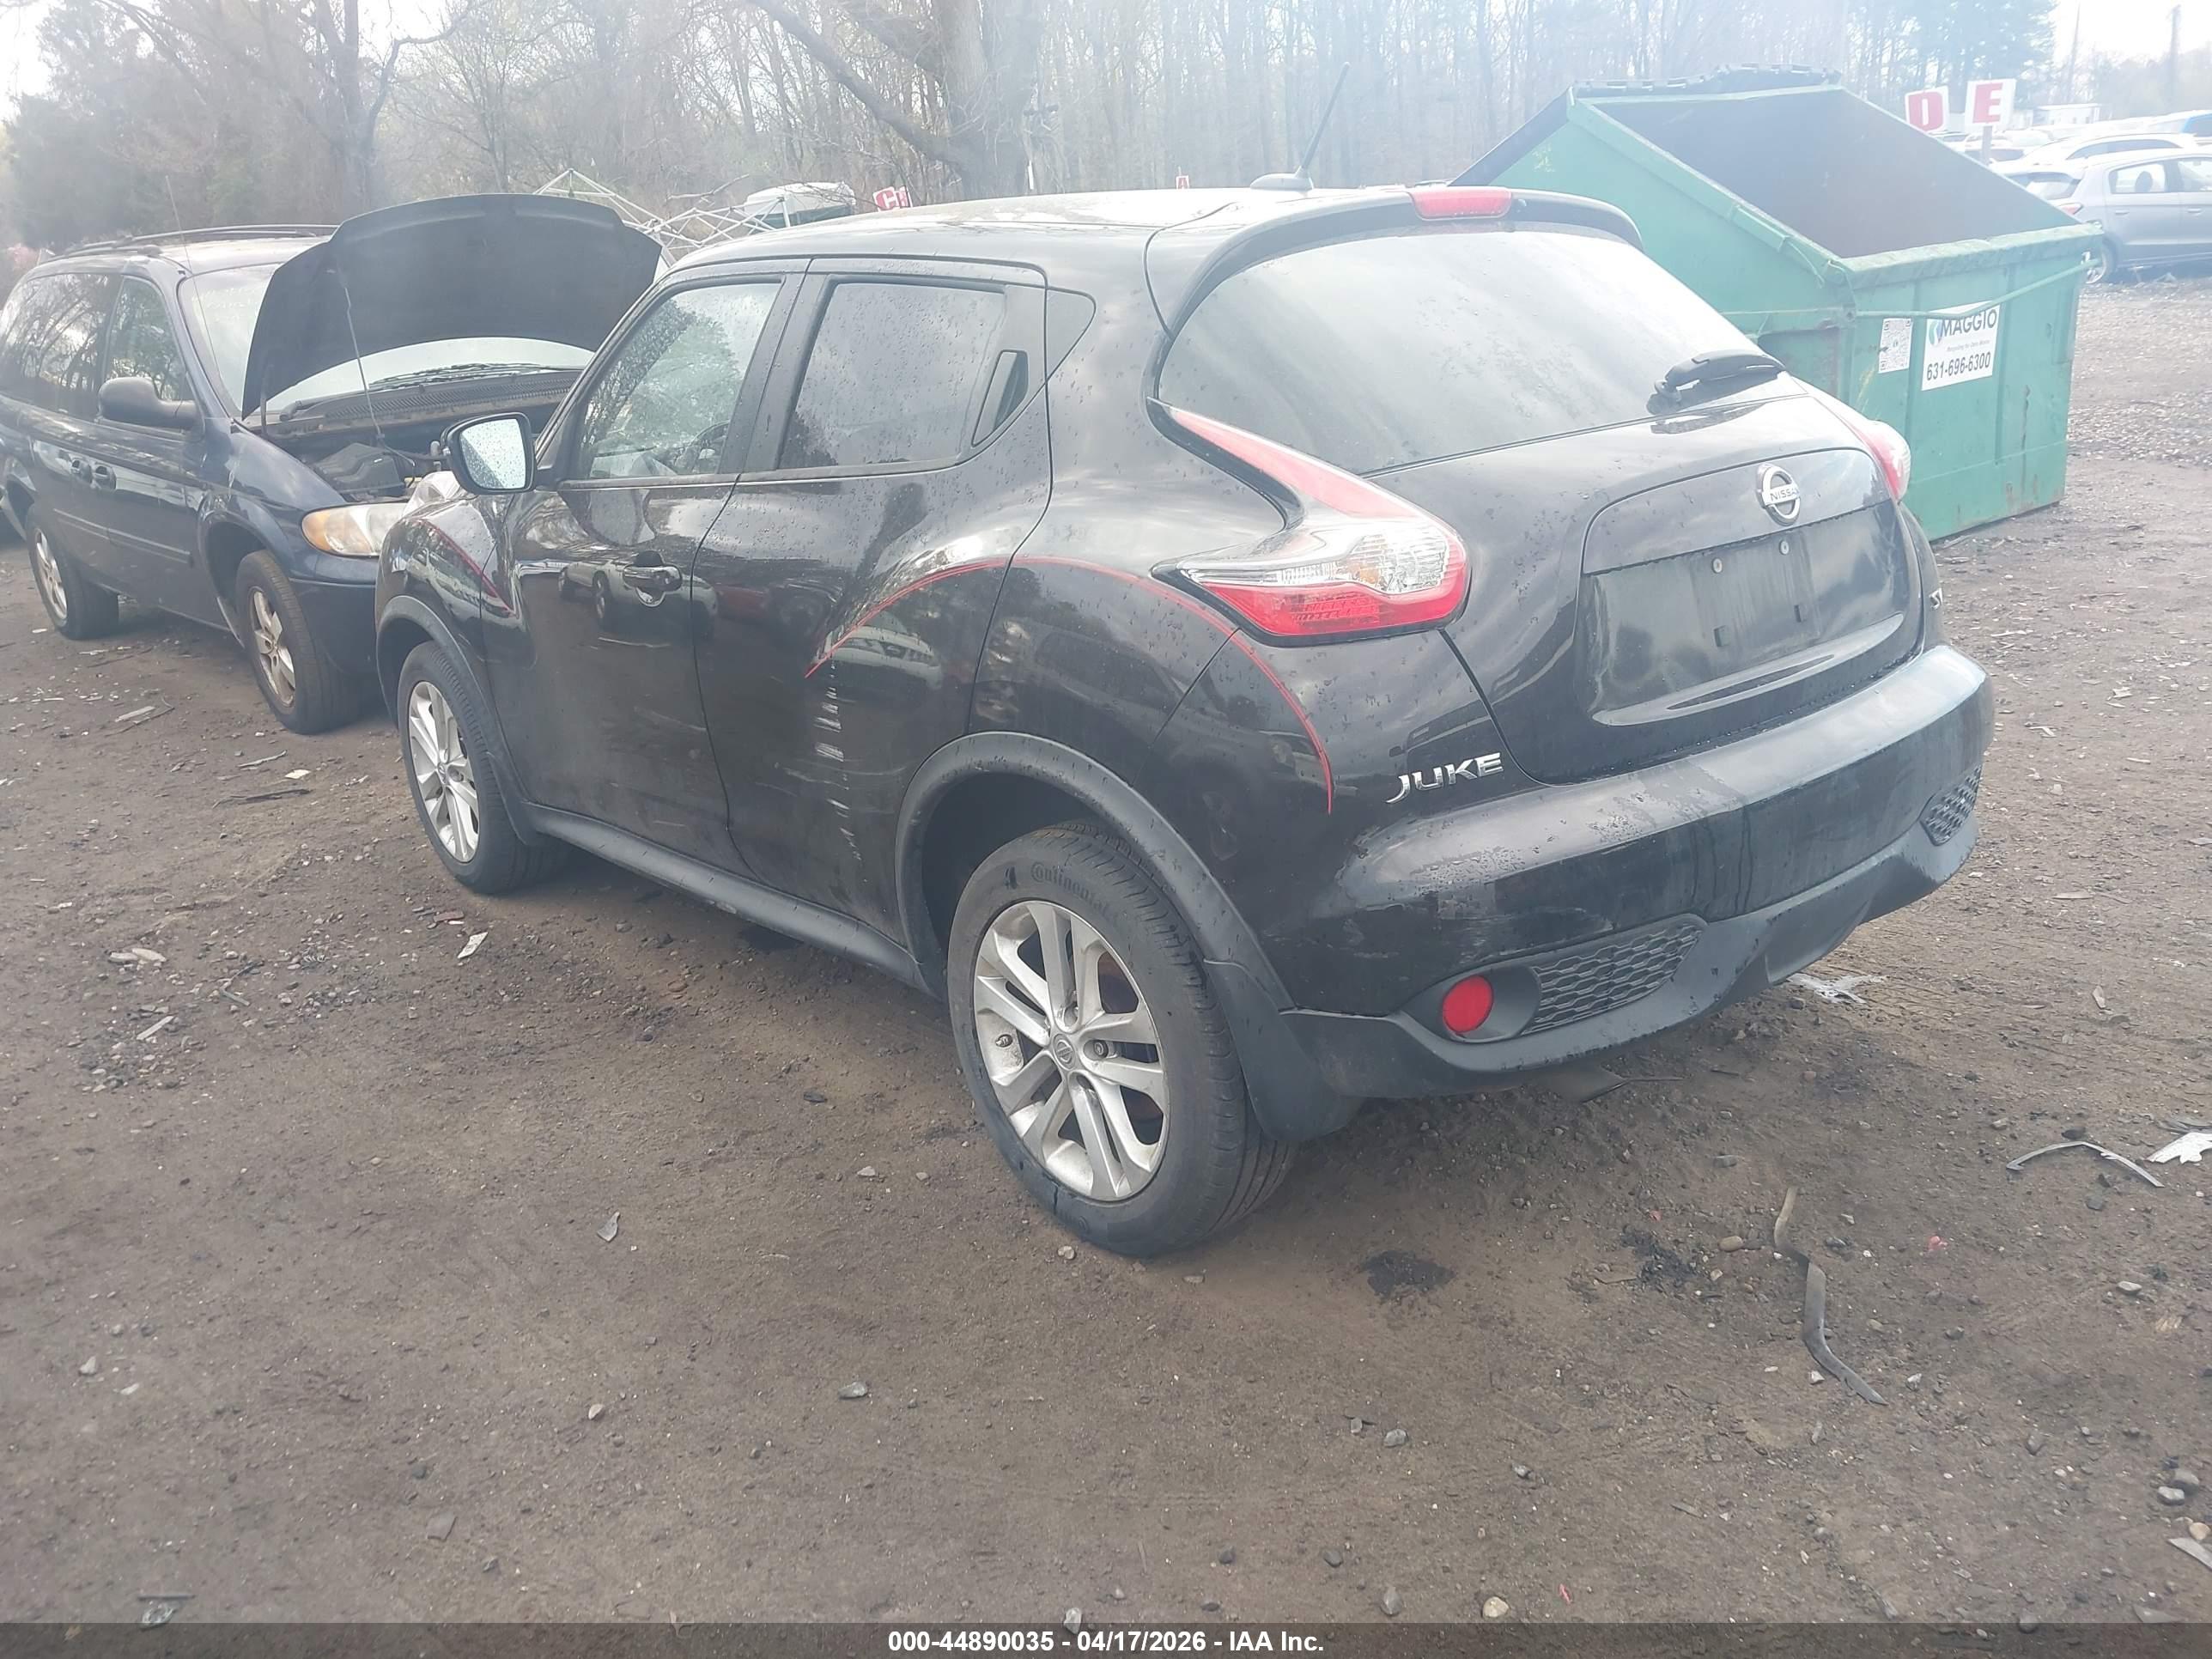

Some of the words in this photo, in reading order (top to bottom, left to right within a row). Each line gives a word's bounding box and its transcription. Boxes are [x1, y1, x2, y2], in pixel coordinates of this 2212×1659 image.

[1972, 82, 2003, 124] E
[1941, 308, 1997, 337] MAGGIO
[1926, 351, 1991, 381] 631-696-6300
[1384, 751, 1504, 805] JUKE
